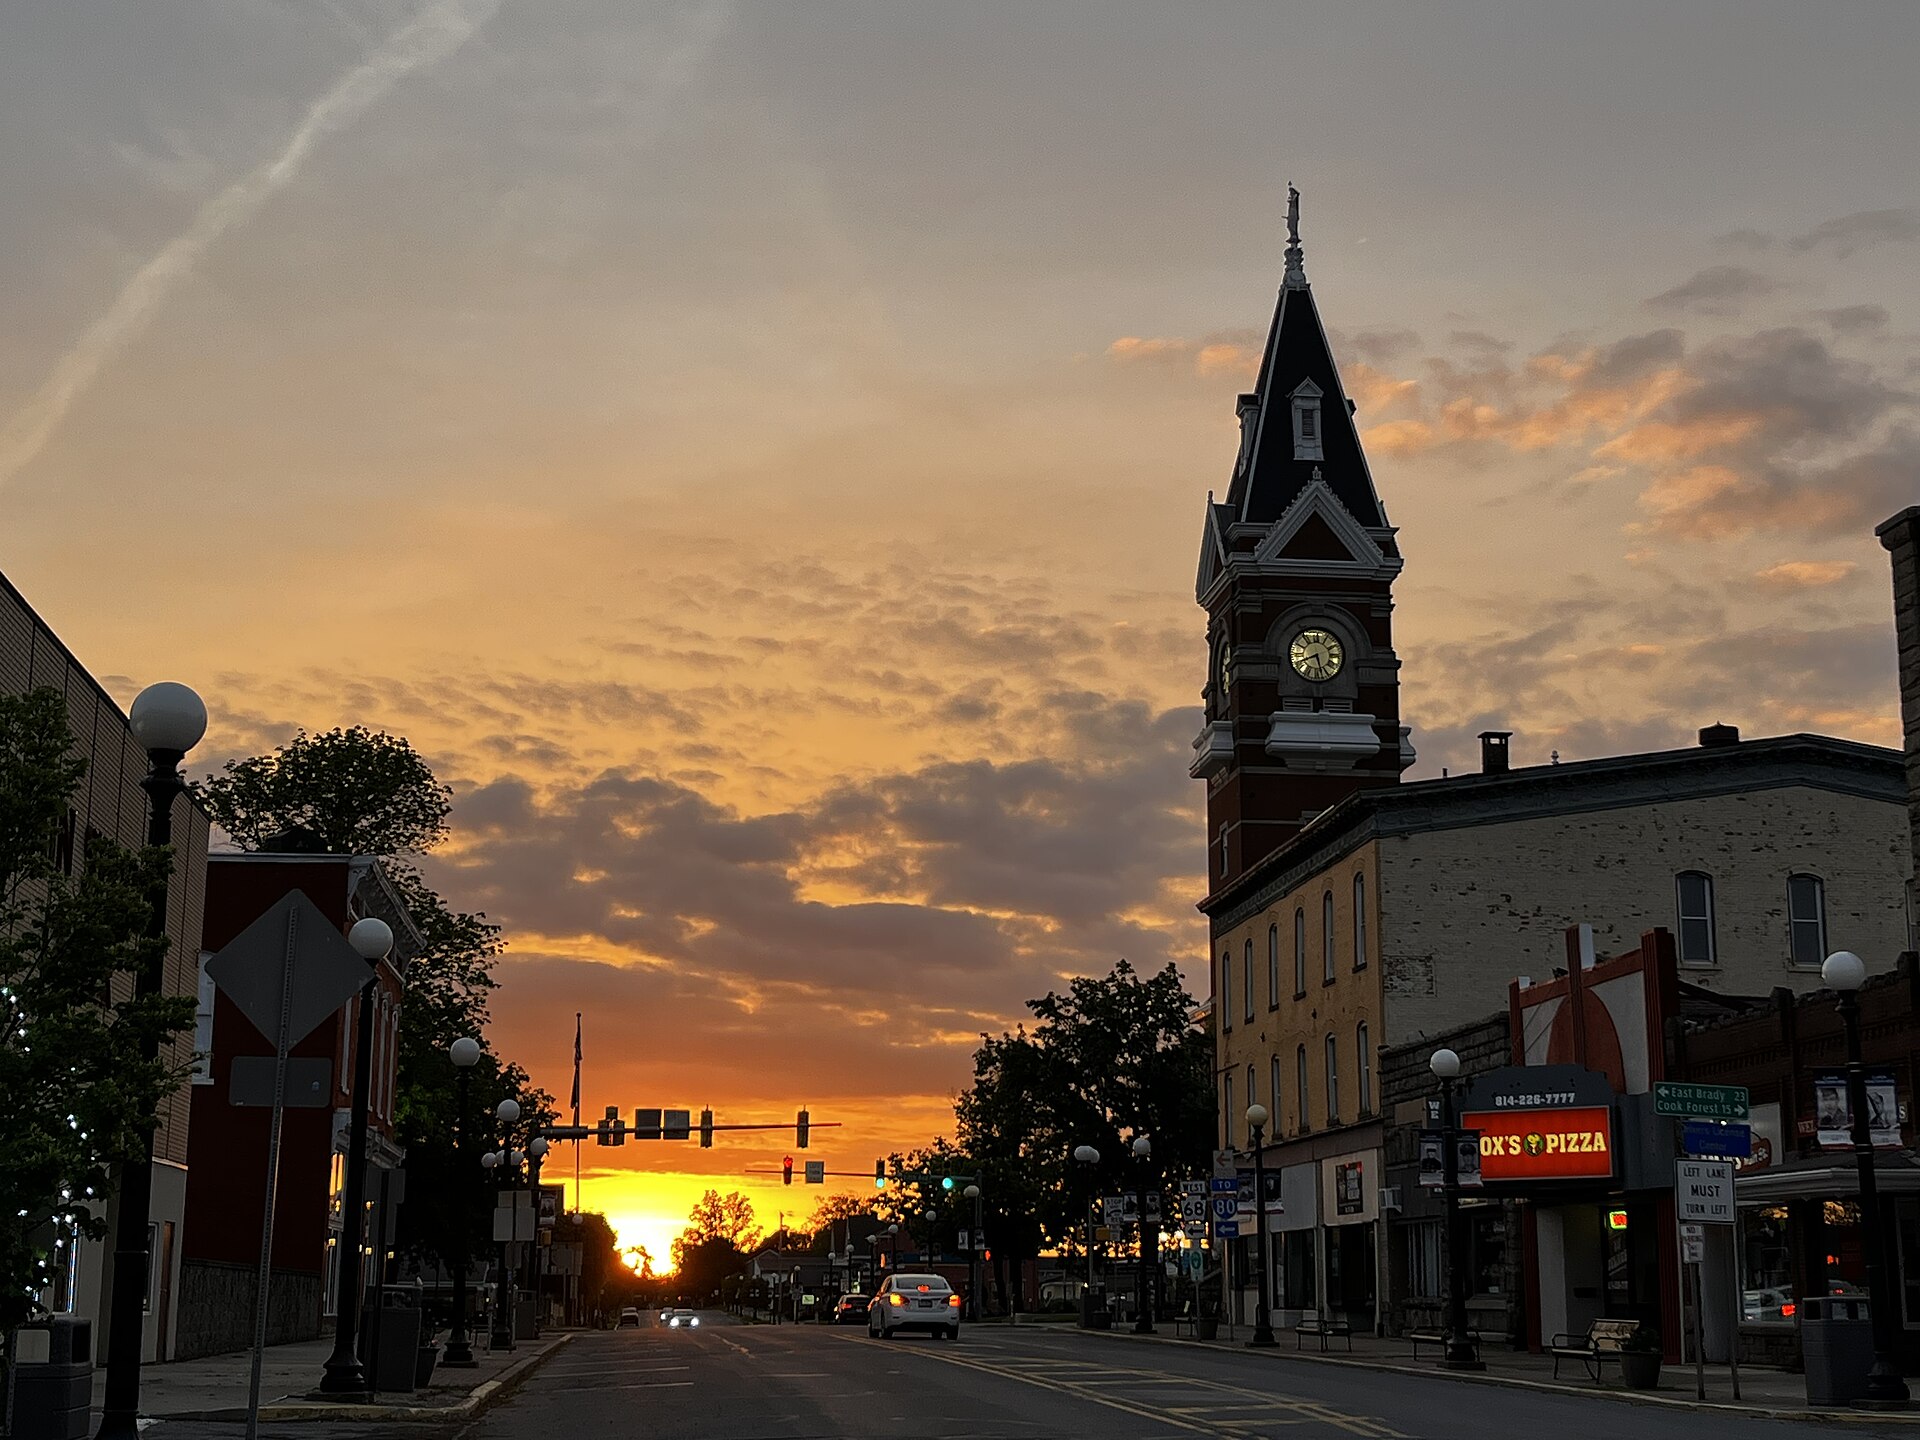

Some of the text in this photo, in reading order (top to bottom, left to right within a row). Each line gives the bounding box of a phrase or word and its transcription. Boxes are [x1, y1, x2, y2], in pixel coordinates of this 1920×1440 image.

[1671, 1087, 1745, 1103] East Brady 23
[1657, 1100, 1731, 1115] Cook Forest 15
[1480, 1131, 1607, 1156] OX'S PIZZA
[1683, 1167, 1726, 1179] LEFT LANE
[1183, 1183, 1203, 1192] WEST
[1217, 1181, 1231, 1189] TO
[1691, 1184, 1720, 1197] MUST
[1183, 1201, 1204, 1216] 68
[1216, 1199, 1236, 1215] 80
[1686, 1203, 1727, 1215] TURN LEFT
